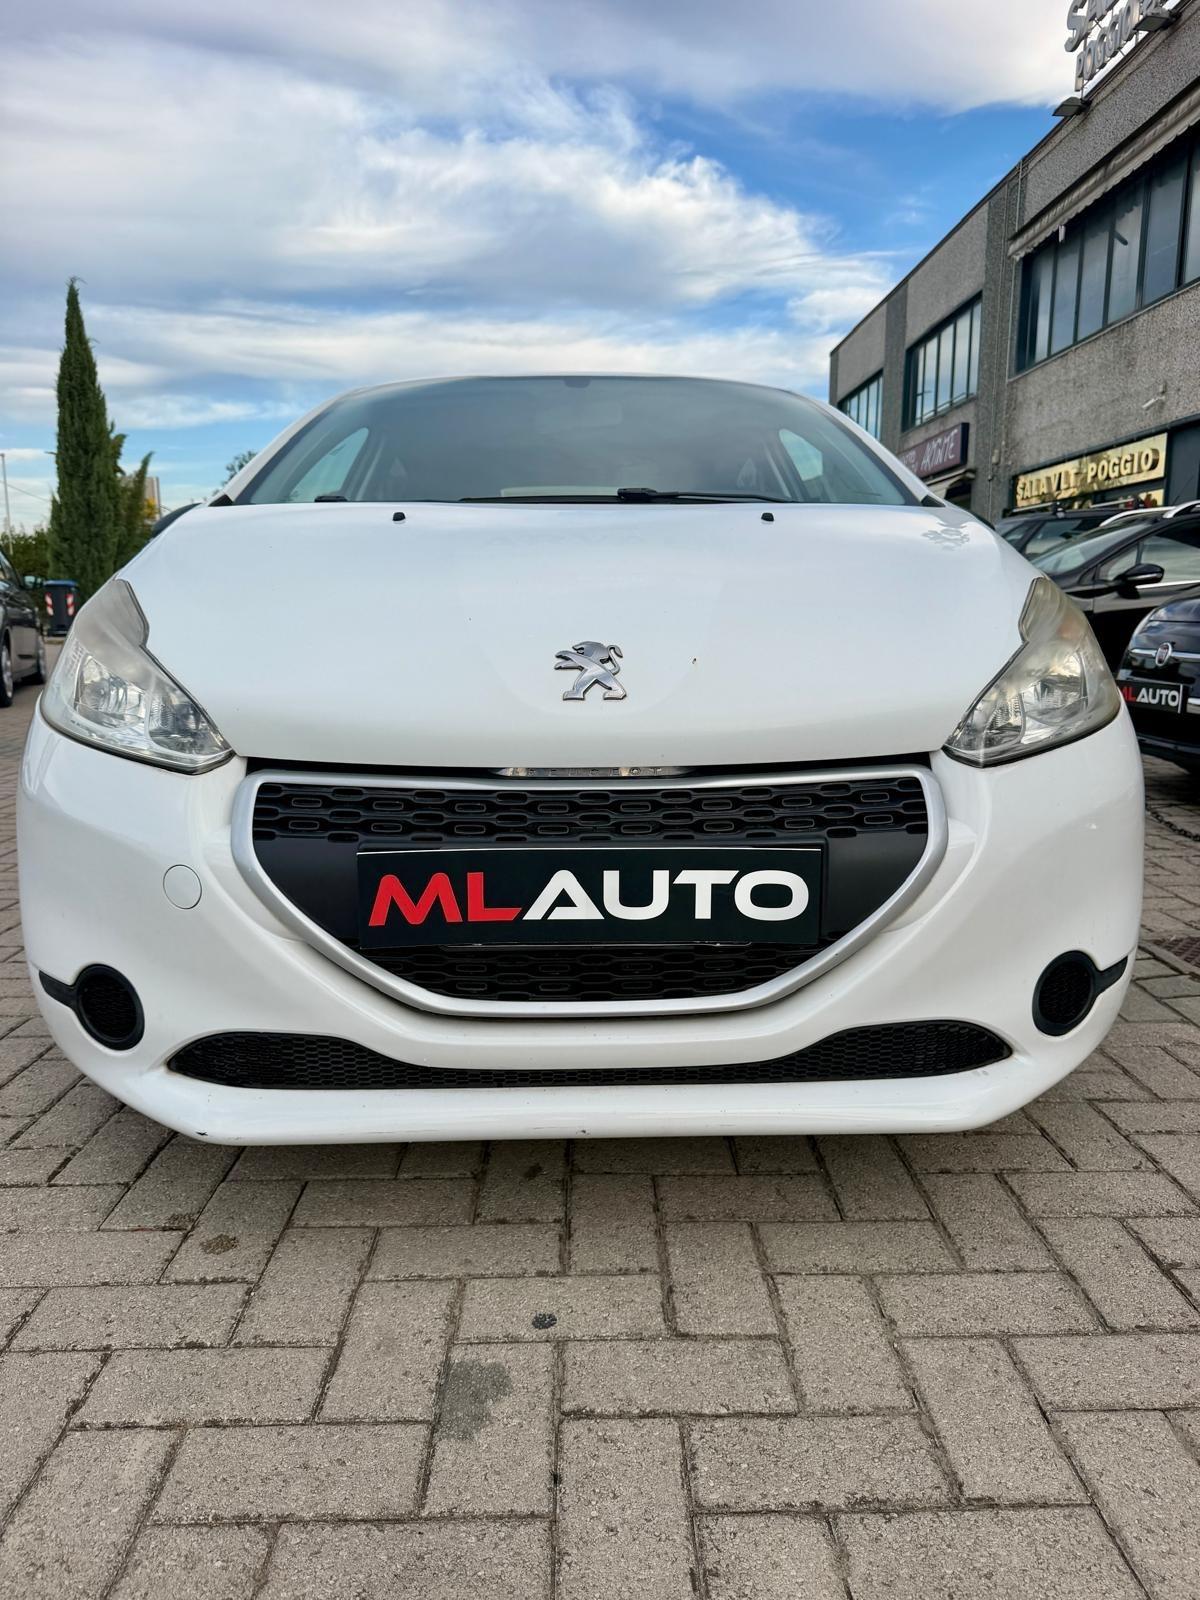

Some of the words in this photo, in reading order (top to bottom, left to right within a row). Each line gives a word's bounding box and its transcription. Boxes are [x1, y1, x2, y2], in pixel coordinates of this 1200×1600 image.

[1016, 476, 1048, 500] SALA
[1087, 449, 1155, 484] POGGIO
[368, 869, 810, 927] MLAUTO
